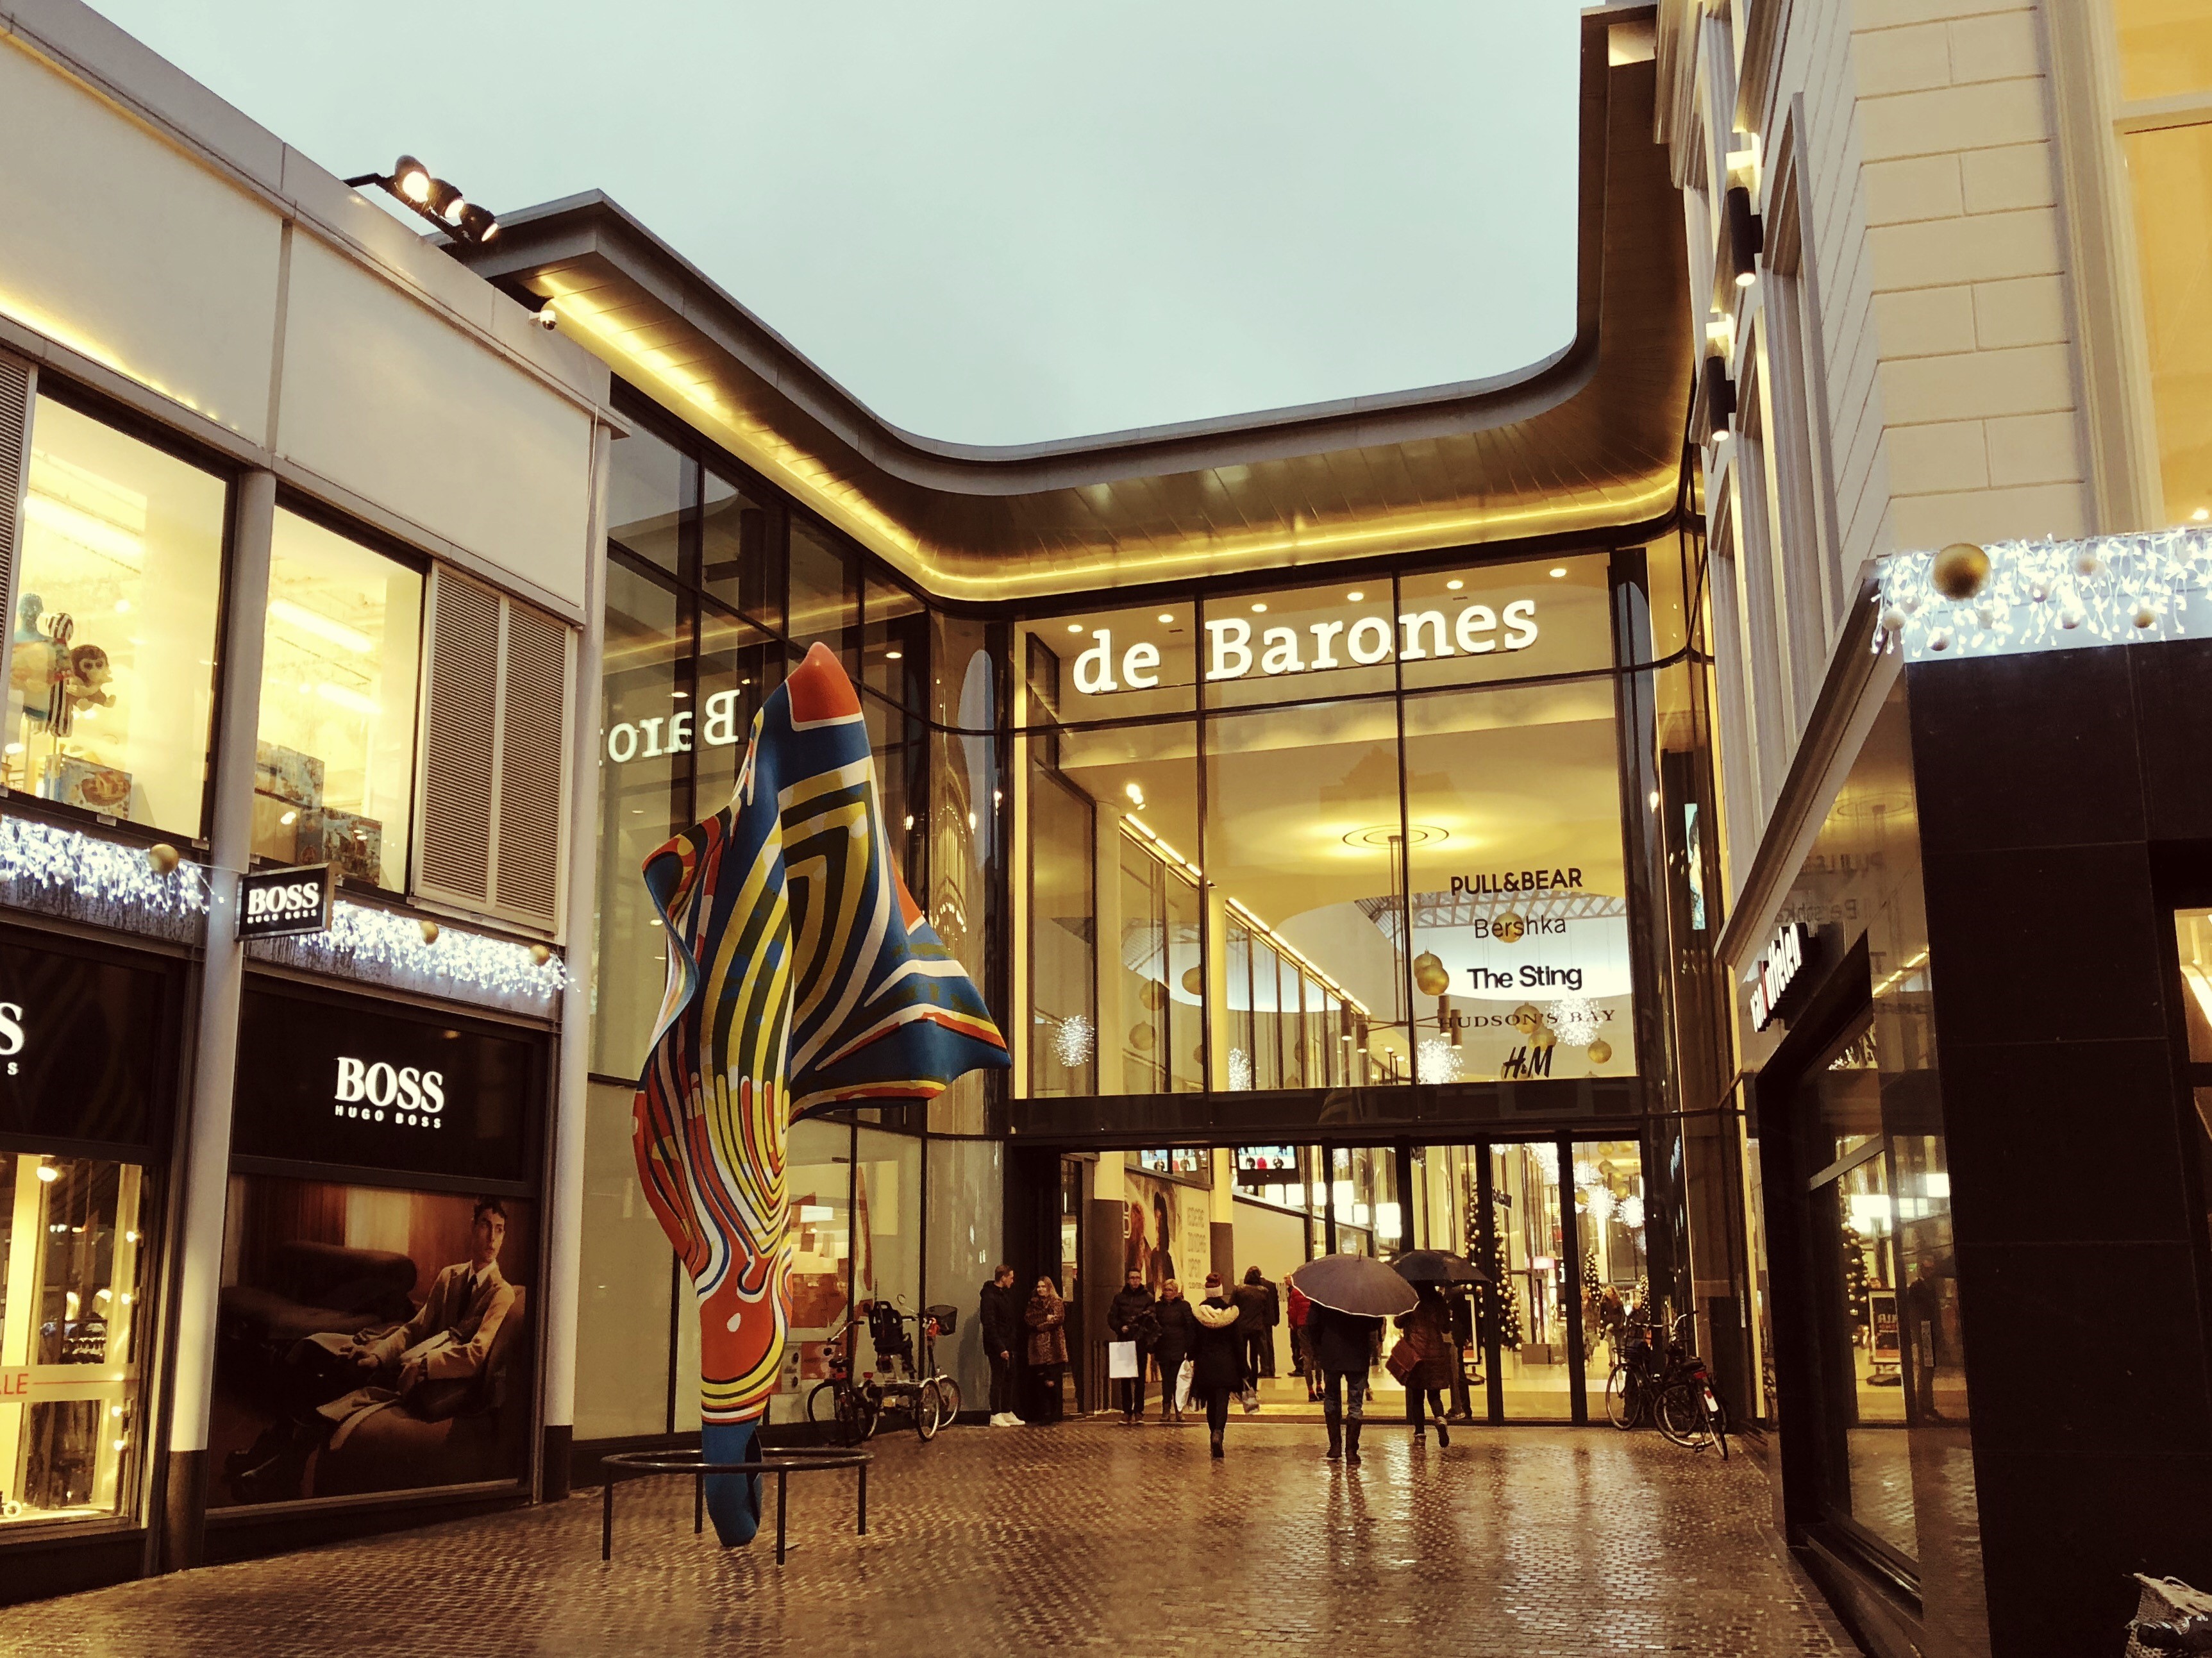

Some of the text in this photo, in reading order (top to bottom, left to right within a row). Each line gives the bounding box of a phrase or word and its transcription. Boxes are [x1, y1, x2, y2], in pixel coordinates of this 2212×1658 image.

[1072, 599, 1539, 694] de Barones
[1450, 867, 1583, 896] PULL&BEAR
[247, 882, 319, 915] BOSS
[1474, 914, 1566, 939] Bershka
[1466, 964, 1582, 991] The Sting
[1502, 1045, 1554, 1079] H&M
[334, 1057, 444, 1113] BOSS
[335, 1105, 441, 1128] HUGO BOSS
